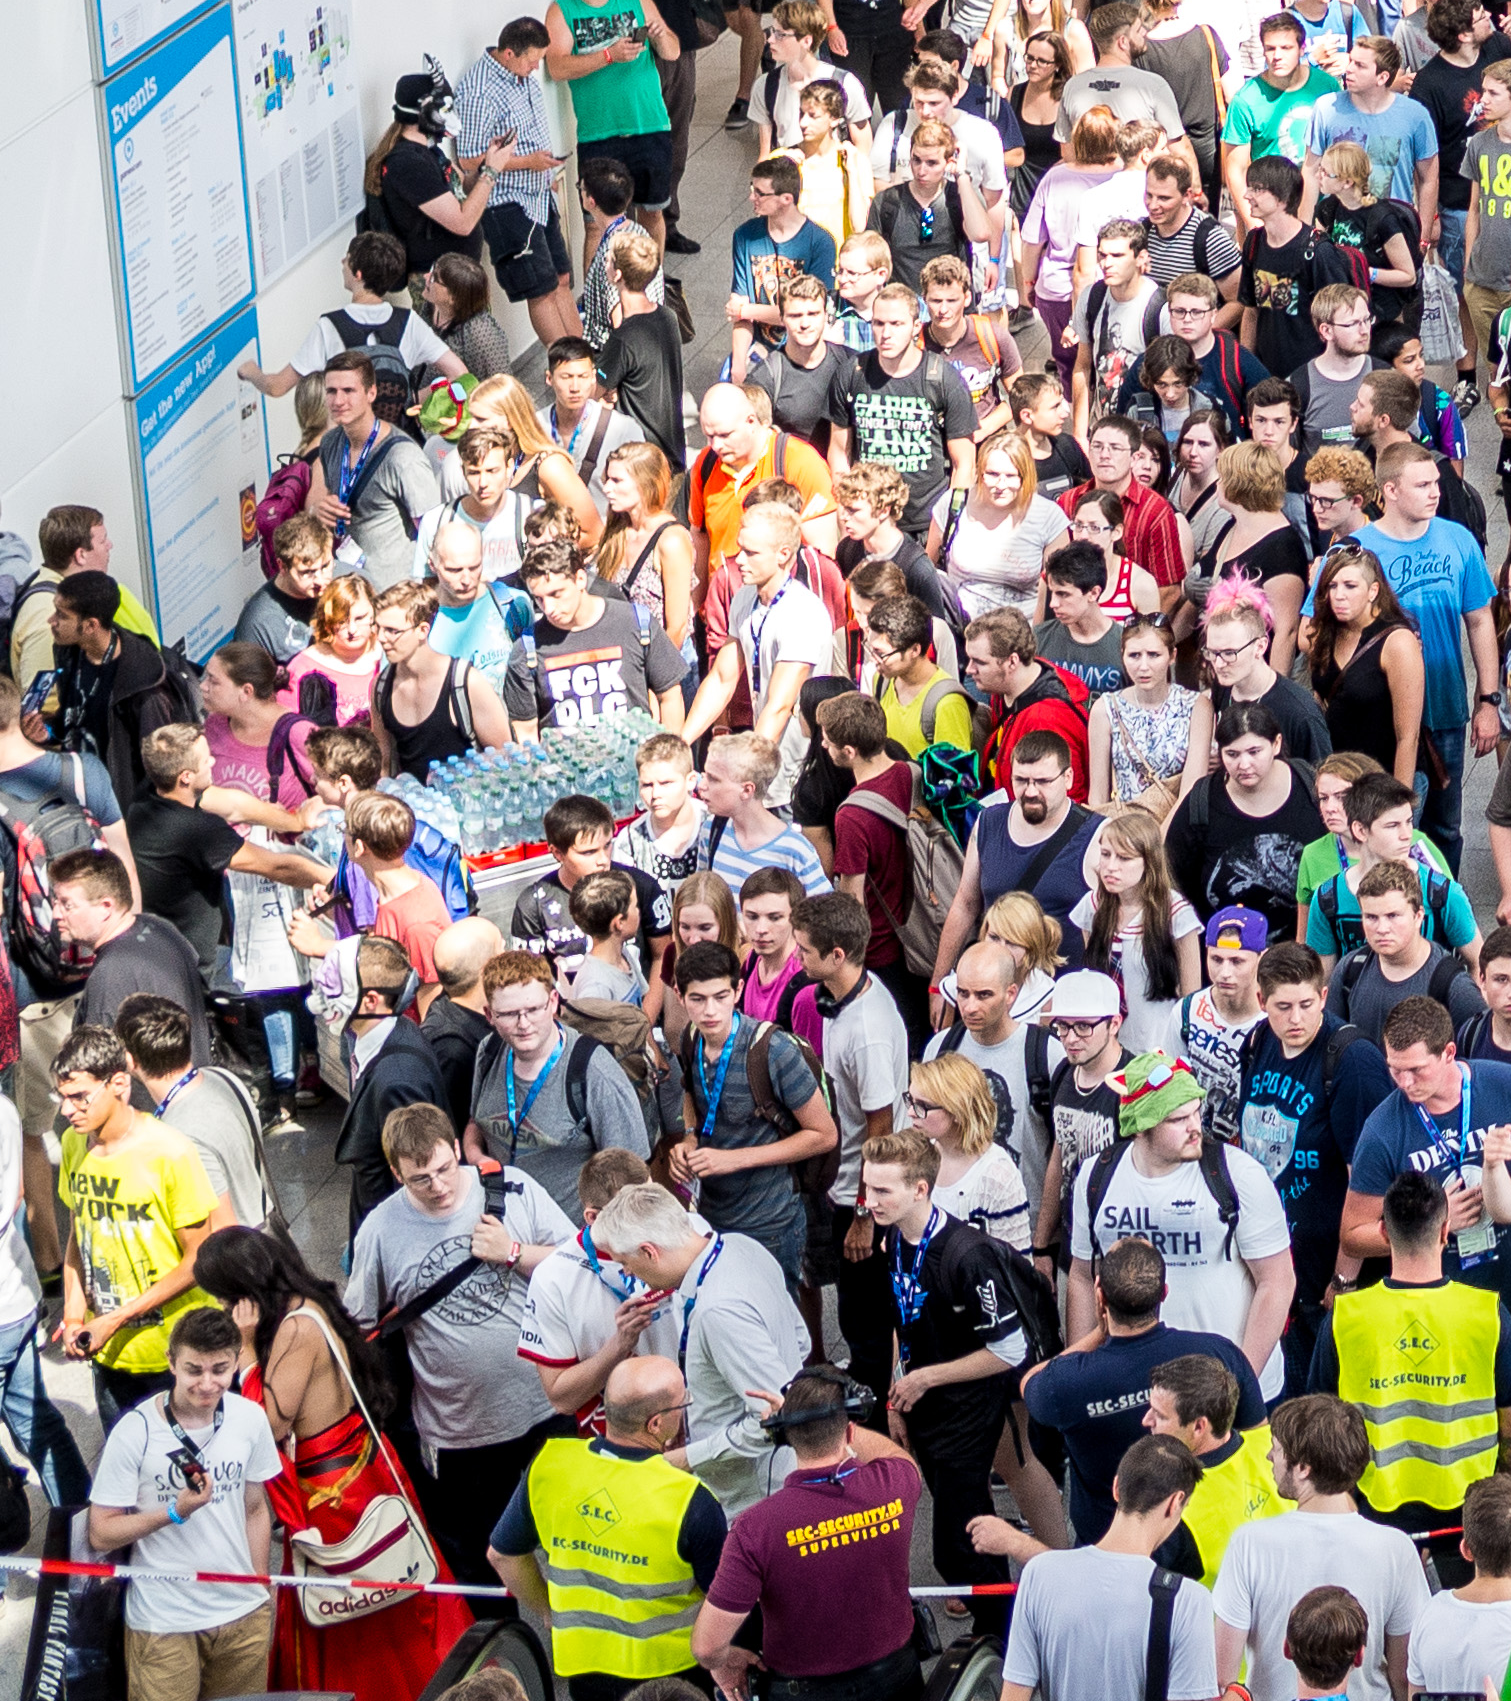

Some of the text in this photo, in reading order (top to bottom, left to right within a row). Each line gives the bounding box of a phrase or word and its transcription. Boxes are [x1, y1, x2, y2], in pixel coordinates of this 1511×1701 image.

[110, 74, 159, 135] Events
[140, 343, 217, 438] Get the new App!
[1389, 554, 1455, 587] Beach
[548, 659, 628, 702] FCK
[554, 695, 629, 728] DLC
[1250, 1071, 1315, 1116] SPORTS
[1294, 1150, 1320, 1170] 96
[1103, 1205, 1160, 1232] SAIL
[1399, 1338, 1435, 1351] S.E.C.
[1369, 1373, 1468, 1391] SEC-SECURITY.DE
[581, 1504, 616, 1523] S.E.C.
[785, 1498, 904, 1547] SEC-SECURITY.DE
[553, 1536, 650, 1567] EC-SECURITY.DE
[799, 1519, 902, 1557] SUPERVISOR
[317, 1585, 400, 1618] adidas
